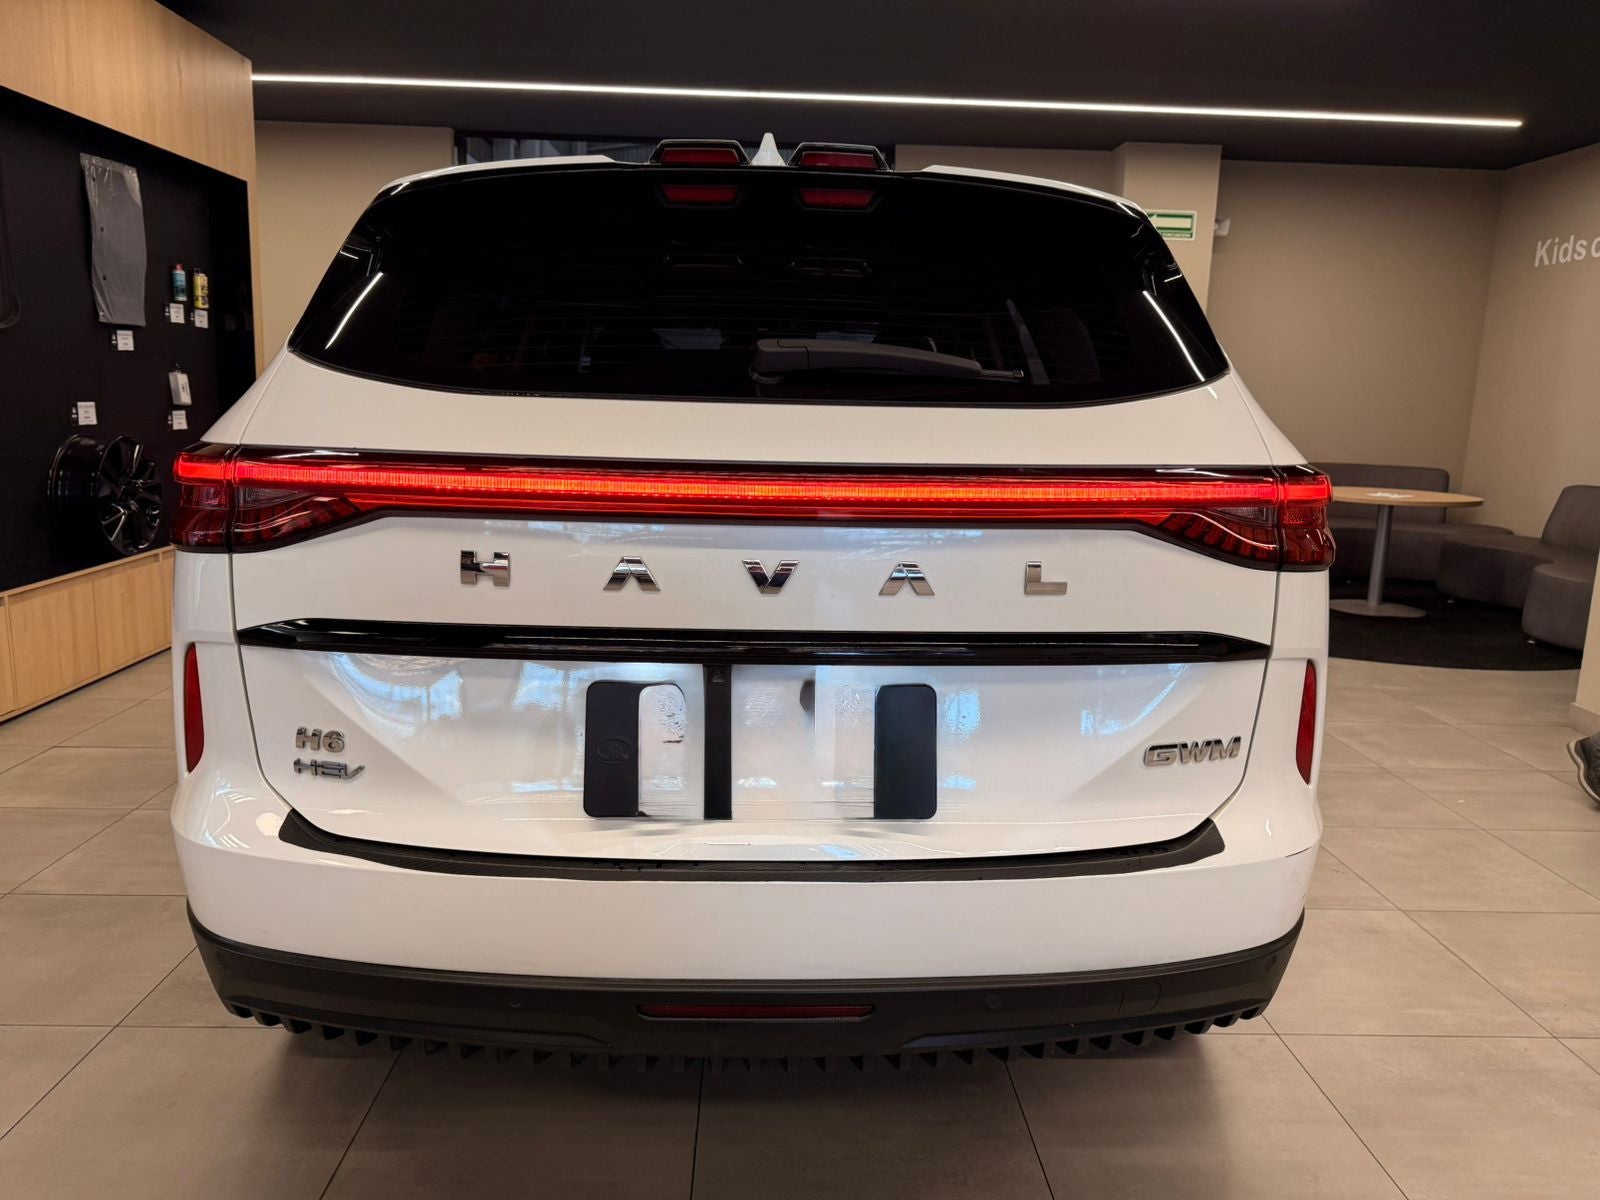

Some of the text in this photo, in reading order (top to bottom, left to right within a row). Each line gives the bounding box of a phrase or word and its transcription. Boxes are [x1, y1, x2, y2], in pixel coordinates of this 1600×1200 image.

[1534, 234, 1588, 268] Kids
[460, 550, 1068, 596] HAVAL
[295, 727, 345, 753] H6
[1143, 736, 1242, 767] GWM
[293, 758, 366, 781] HEV
